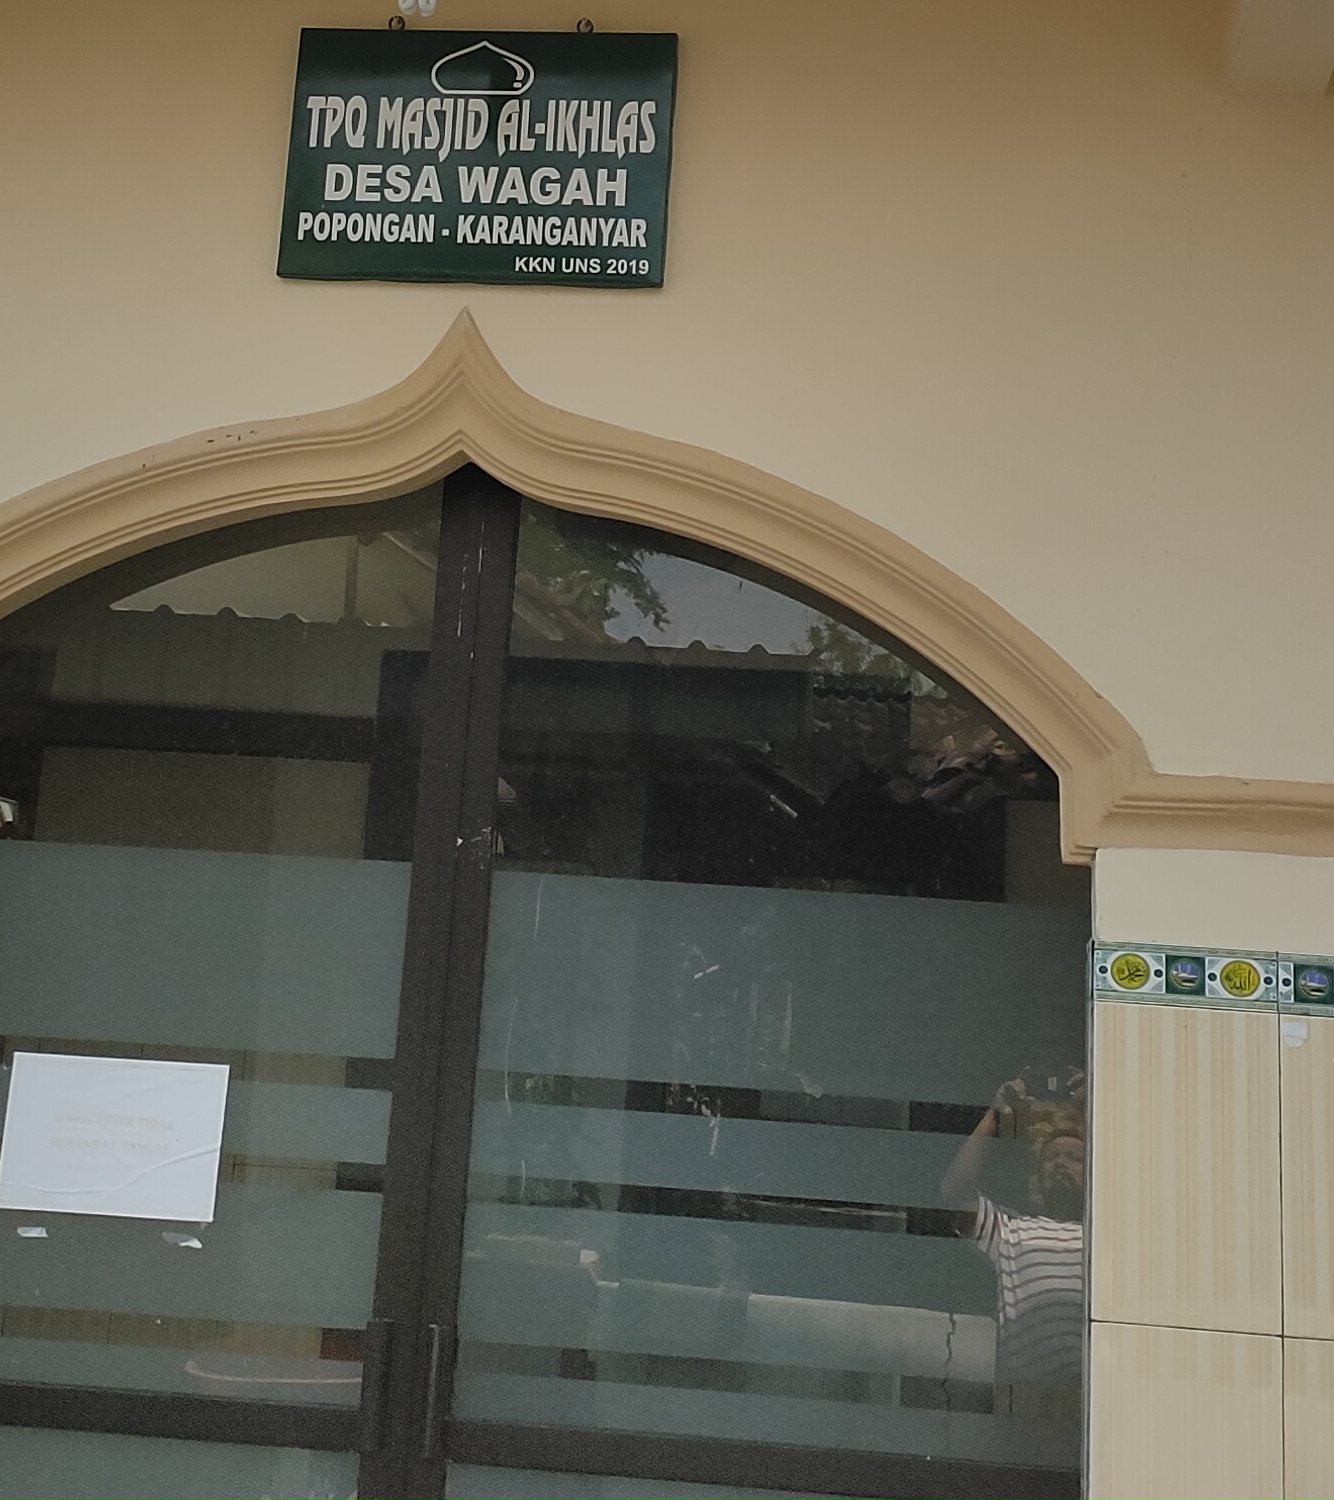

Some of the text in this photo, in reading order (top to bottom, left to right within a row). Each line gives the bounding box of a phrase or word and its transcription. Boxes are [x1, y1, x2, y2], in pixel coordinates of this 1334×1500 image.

[306, 95, 657, 163] TPQ MASJID AL-IKHLAS
[323, 163, 629, 207] DESA WAGAH
[297, 210, 436, 244] POPONGAN
[455, 214, 648, 249] KARANGANYAR
[514, 255, 650, 276] KKN UNS 2019
